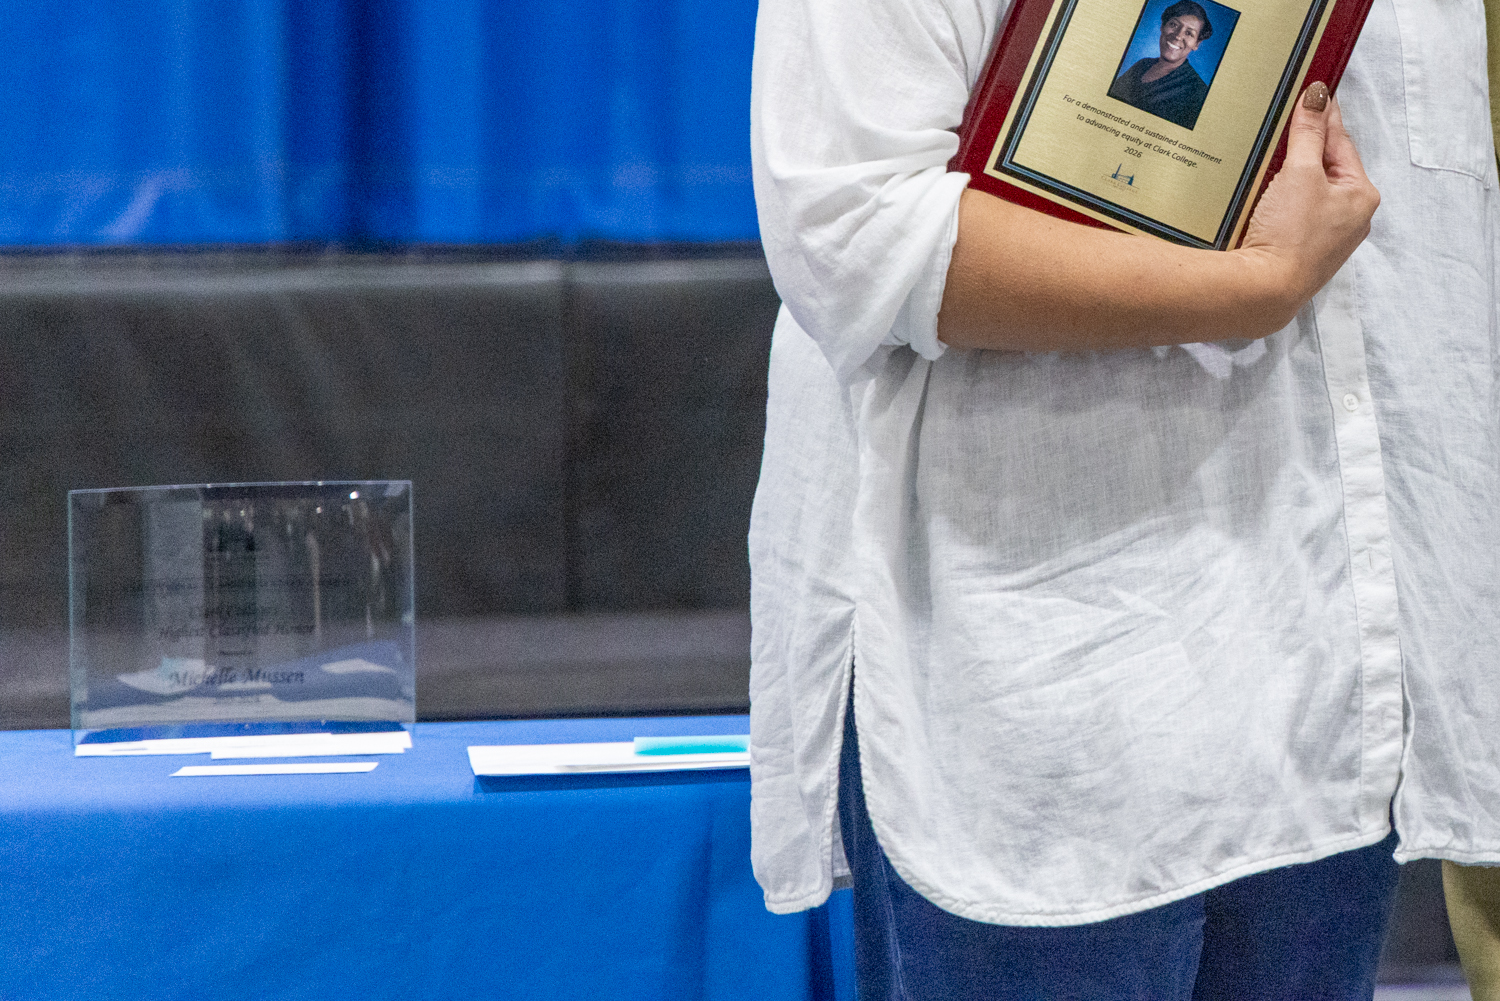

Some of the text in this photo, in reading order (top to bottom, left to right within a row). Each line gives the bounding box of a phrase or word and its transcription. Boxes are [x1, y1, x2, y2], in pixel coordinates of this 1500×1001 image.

[1063, 94, 1074, 105] For
[1081, 102, 1131, 127] demonstrated
[1130, 121, 1145, 133] and
[1144, 128, 1179, 146] sustained
[1178, 142, 1223, 165] commitment
[1076, 113, 1198, 169] to advancing equity at Clark College.
[1123, 146, 1143, 159] 2026
[169, 668, 237, 688] Michelle
